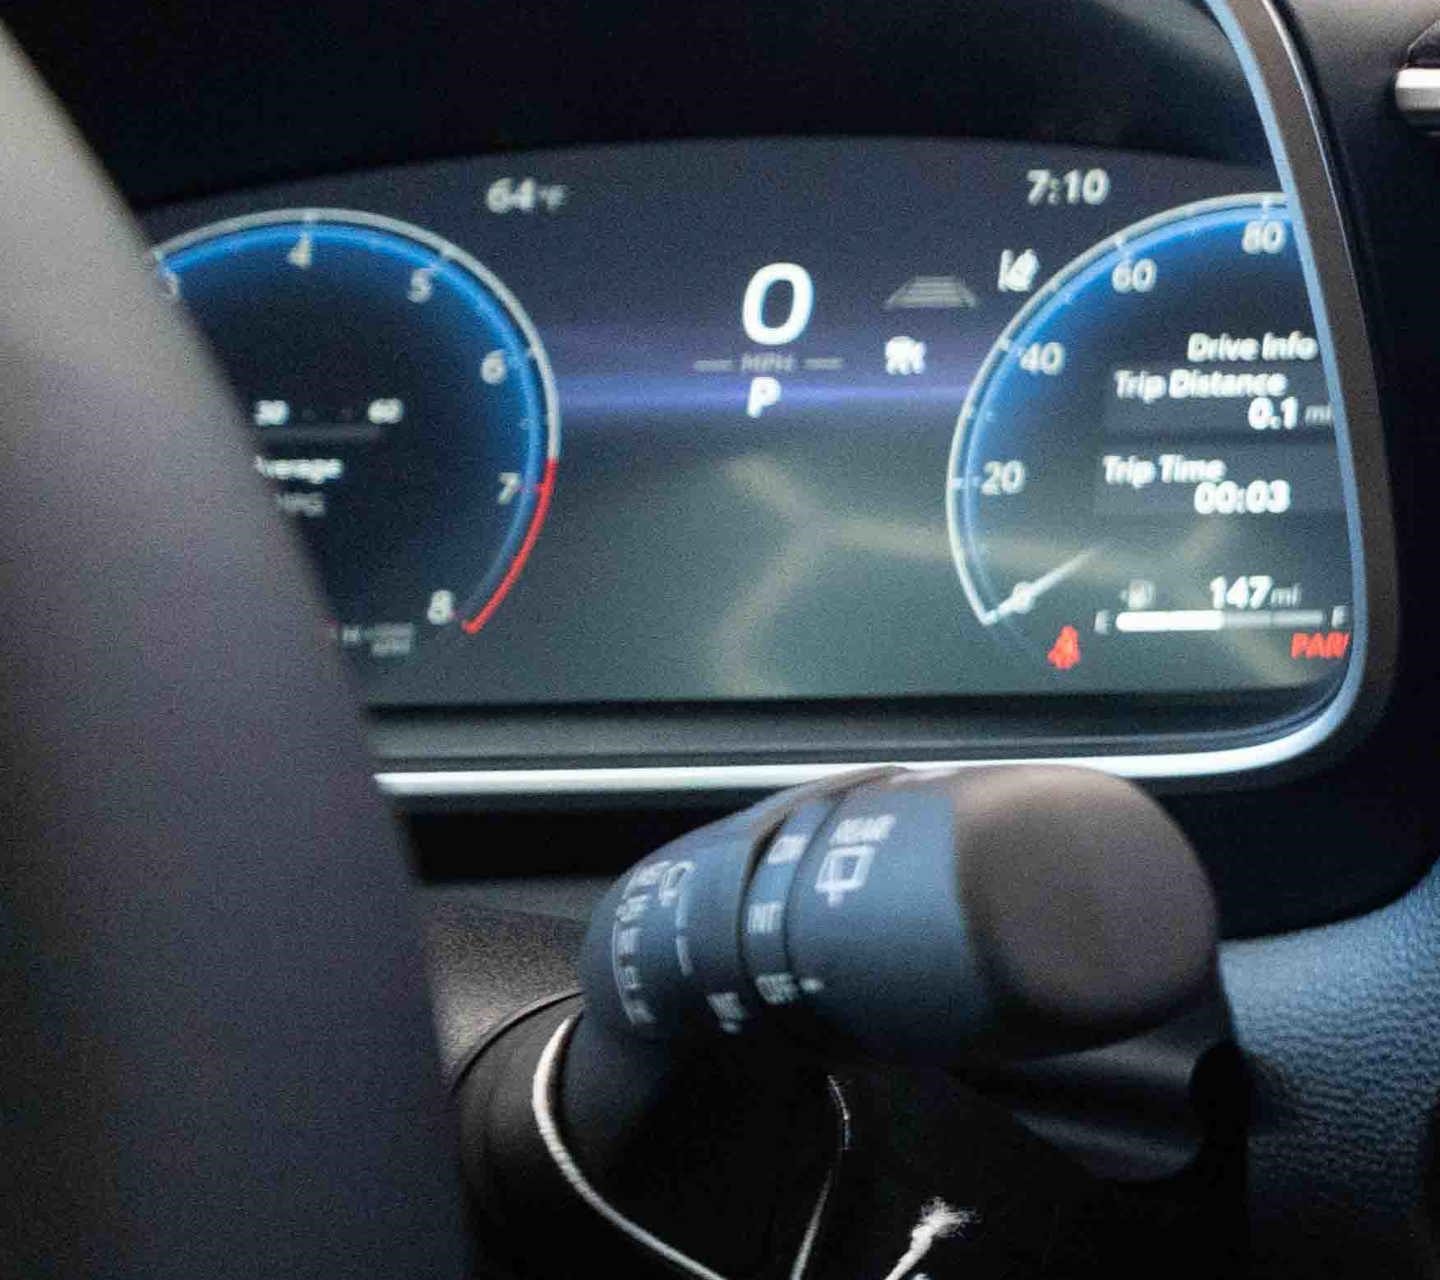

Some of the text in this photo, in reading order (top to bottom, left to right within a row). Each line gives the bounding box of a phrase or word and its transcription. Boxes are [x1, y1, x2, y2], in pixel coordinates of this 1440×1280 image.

[1026, 167, 1109, 206] 7:10
[288, 232, 312, 269] 4
[1242, 218, 1286, 255] 80
[407, 268, 432, 303] 5
[1111, 257, 1157, 293] 60
[742, 262, 813, 345] 0
[1019, 341, 1065, 375] 40
[1188, 331, 1318, 362] Drive Info
[480, 349, 507, 385] 6
[746, 376, 782, 418] P
[1114, 369, 1288, 404] Trip Distance
[1247, 397, 1298, 430] 0.1
[499, 471, 522, 505] 7
[982, 459, 1026, 496] 20
[1102, 455, 1227, 489] Trip Time
[1194, 480, 1291, 514] 00:03
[427, 590, 455, 626] 8
[1210, 575, 1272, 609] 147
